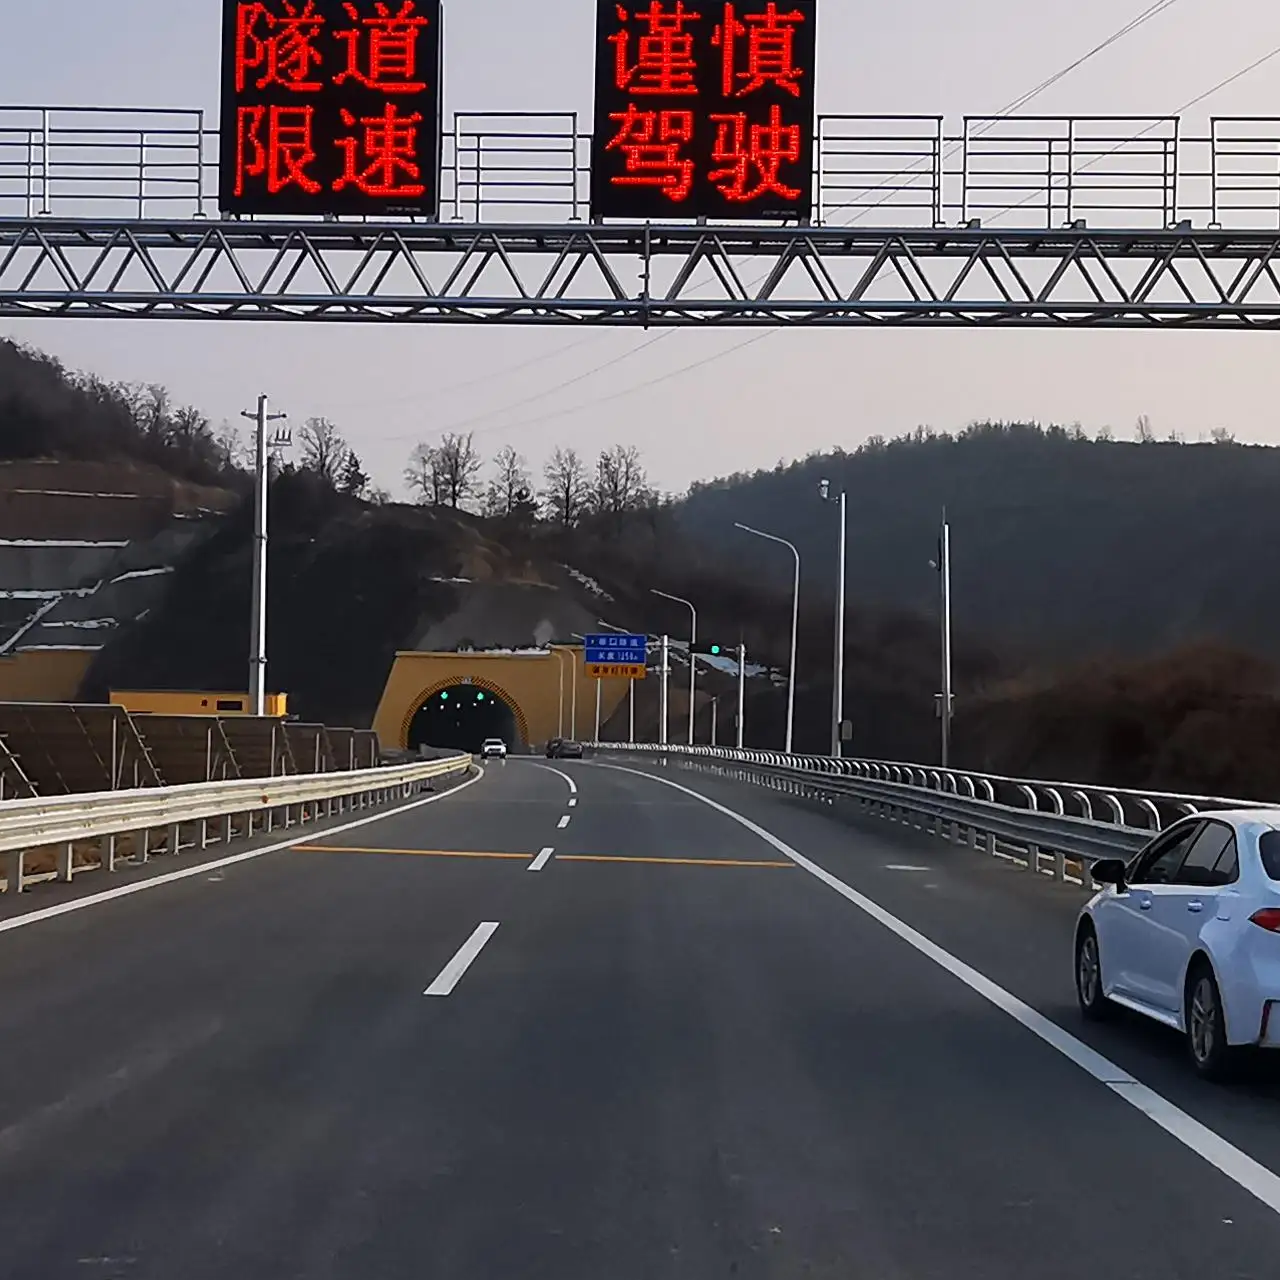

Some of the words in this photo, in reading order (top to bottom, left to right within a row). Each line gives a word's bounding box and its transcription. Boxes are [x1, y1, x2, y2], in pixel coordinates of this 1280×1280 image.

[235, 0, 428, 93] 隧道
[608, 0, 804, 96] 谨慎
[234, 103, 425, 196] 限速
[607, 104, 800, 202] 驾驶
